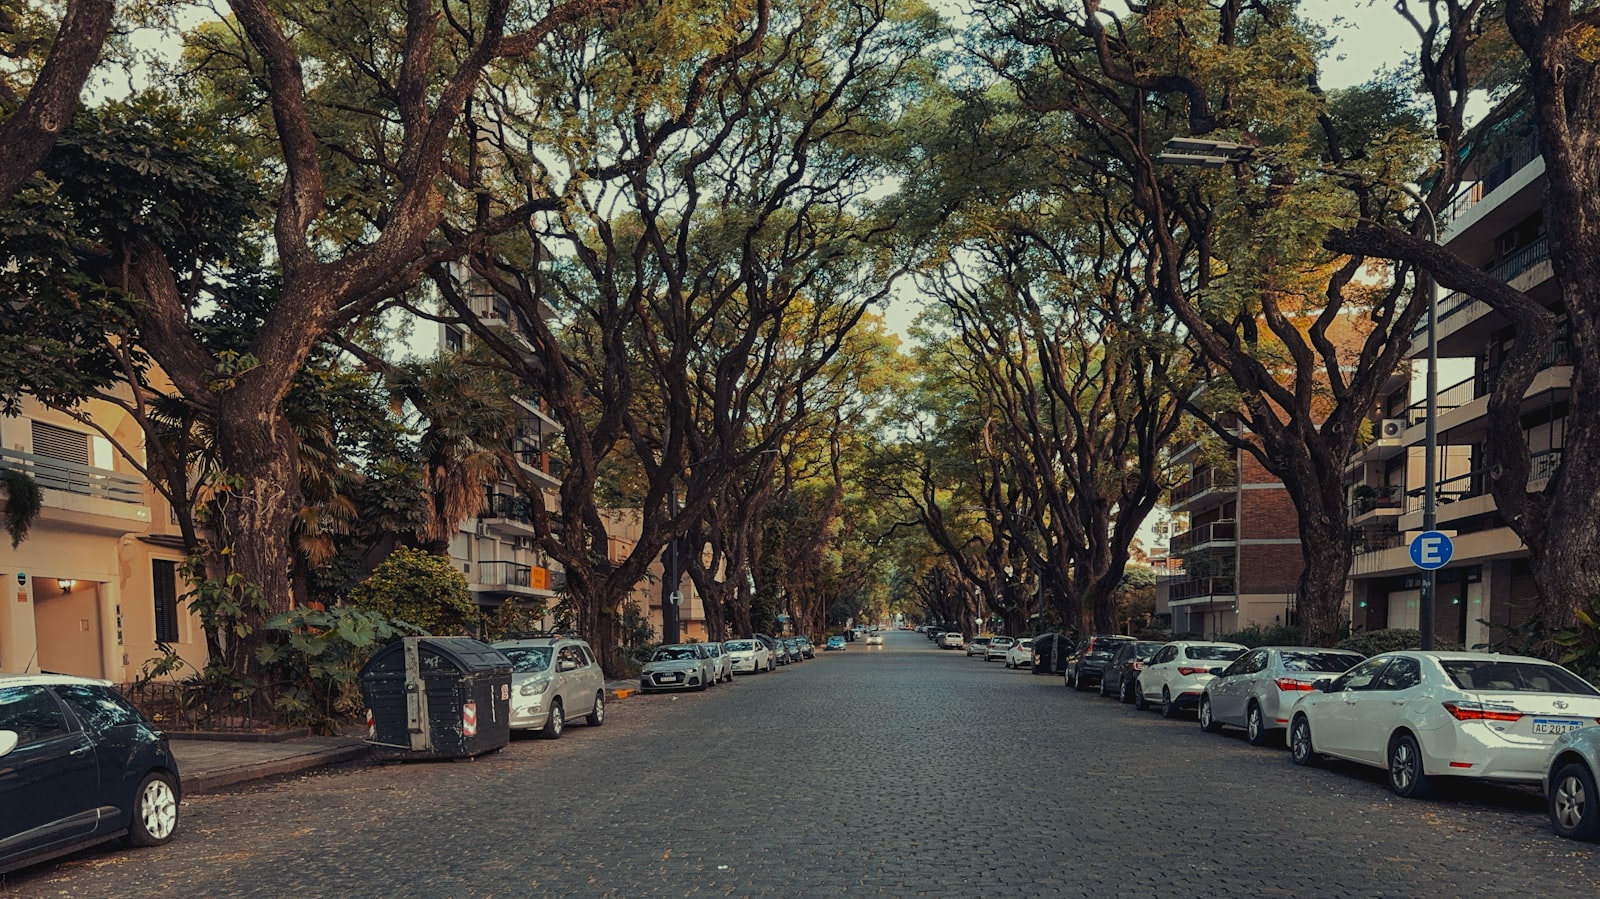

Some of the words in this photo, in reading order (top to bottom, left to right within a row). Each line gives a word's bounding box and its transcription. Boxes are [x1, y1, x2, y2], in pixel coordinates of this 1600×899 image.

[1421, 537, 1441, 563] E
[1536, 724, 1547, 733] AC
[1549, 724, 1566, 734] 201
